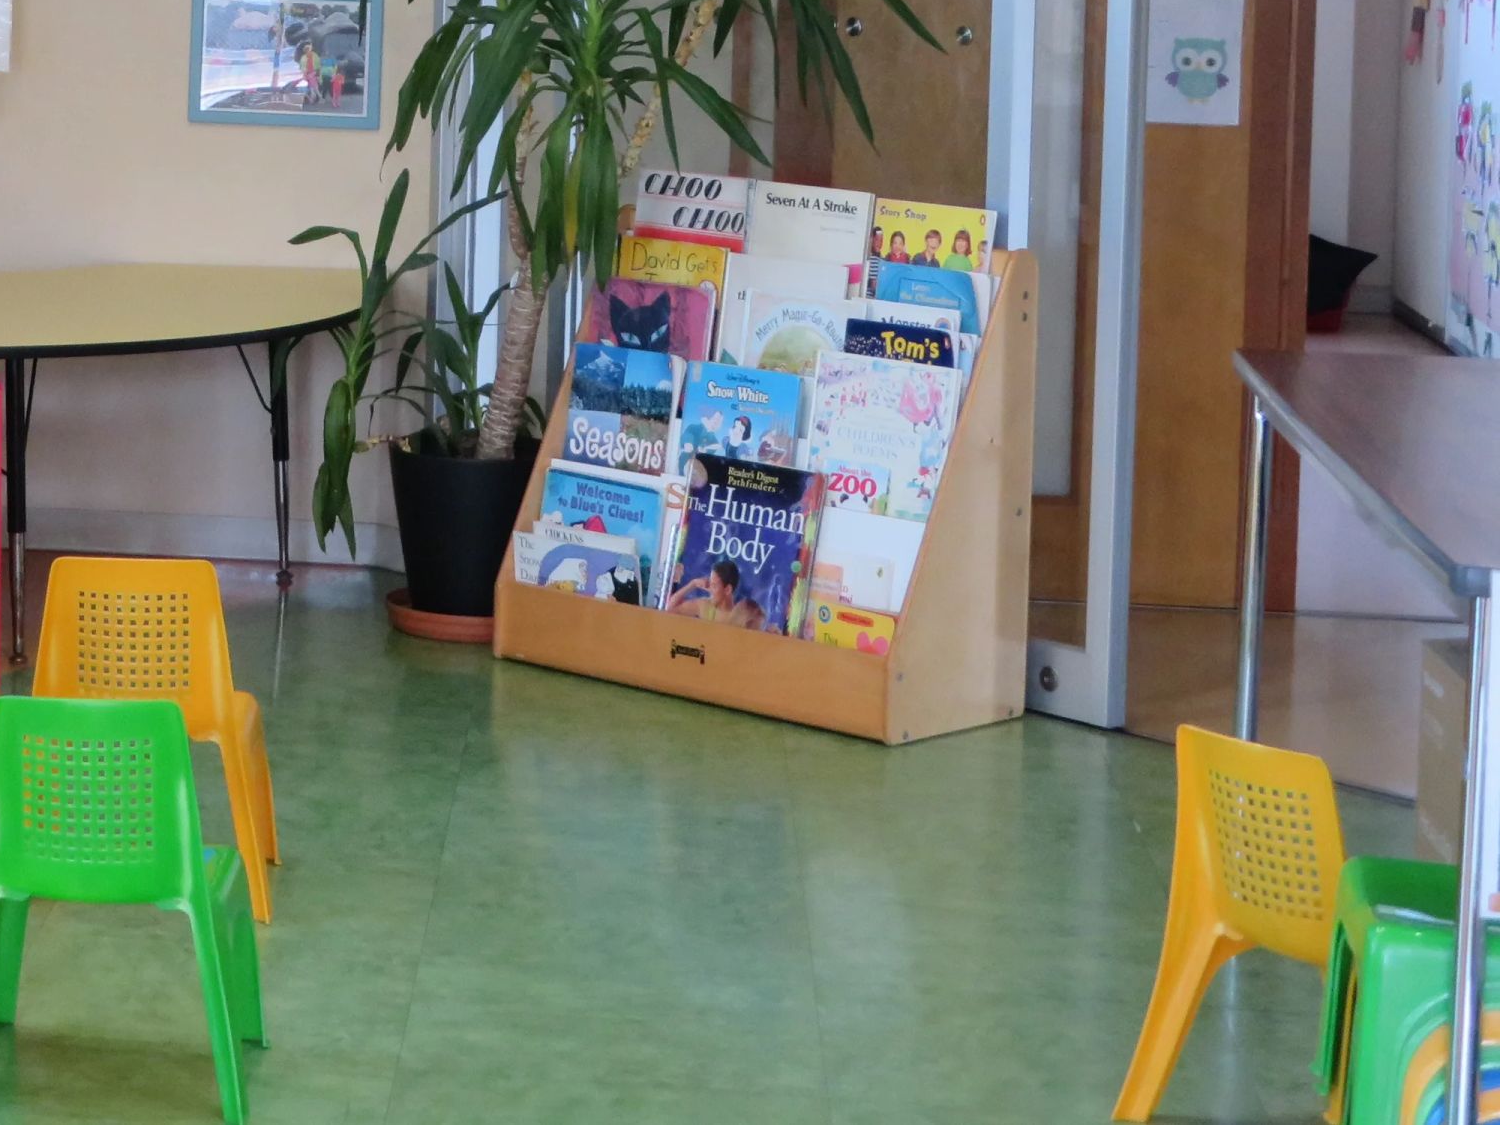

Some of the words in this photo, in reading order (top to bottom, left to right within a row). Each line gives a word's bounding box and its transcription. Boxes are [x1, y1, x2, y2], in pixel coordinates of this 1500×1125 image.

[644, 173, 723, 202] CHOO
[766, 192, 797, 209] Seven
[798, 196, 810, 209] At
[812, 198, 821, 211] A
[823, 199, 859, 216] Stroke
[904, 208, 928, 221] Shop
[672, 206, 745, 233] CHOO
[630, 241, 680, 272] David
[685, 253, 719, 274] Gets
[880, 331, 941, 361] Tom's
[706, 380, 735, 400] Snow
[737, 386, 770, 405] White
[569, 416, 664, 470] Seasons
[726, 475, 777, 494] Pathfinders
[727, 466, 756, 481] Reader's
[756, 471, 780, 485] Digest
[576, 481, 631, 504] Welcome
[557, 497, 569, 508] to
[570, 497, 605, 514] Blue's
[607, 504, 645, 524] Clues!
[687, 495, 707, 513] The
[705, 483, 805, 535] Human
[706, 520, 775, 575] Body
